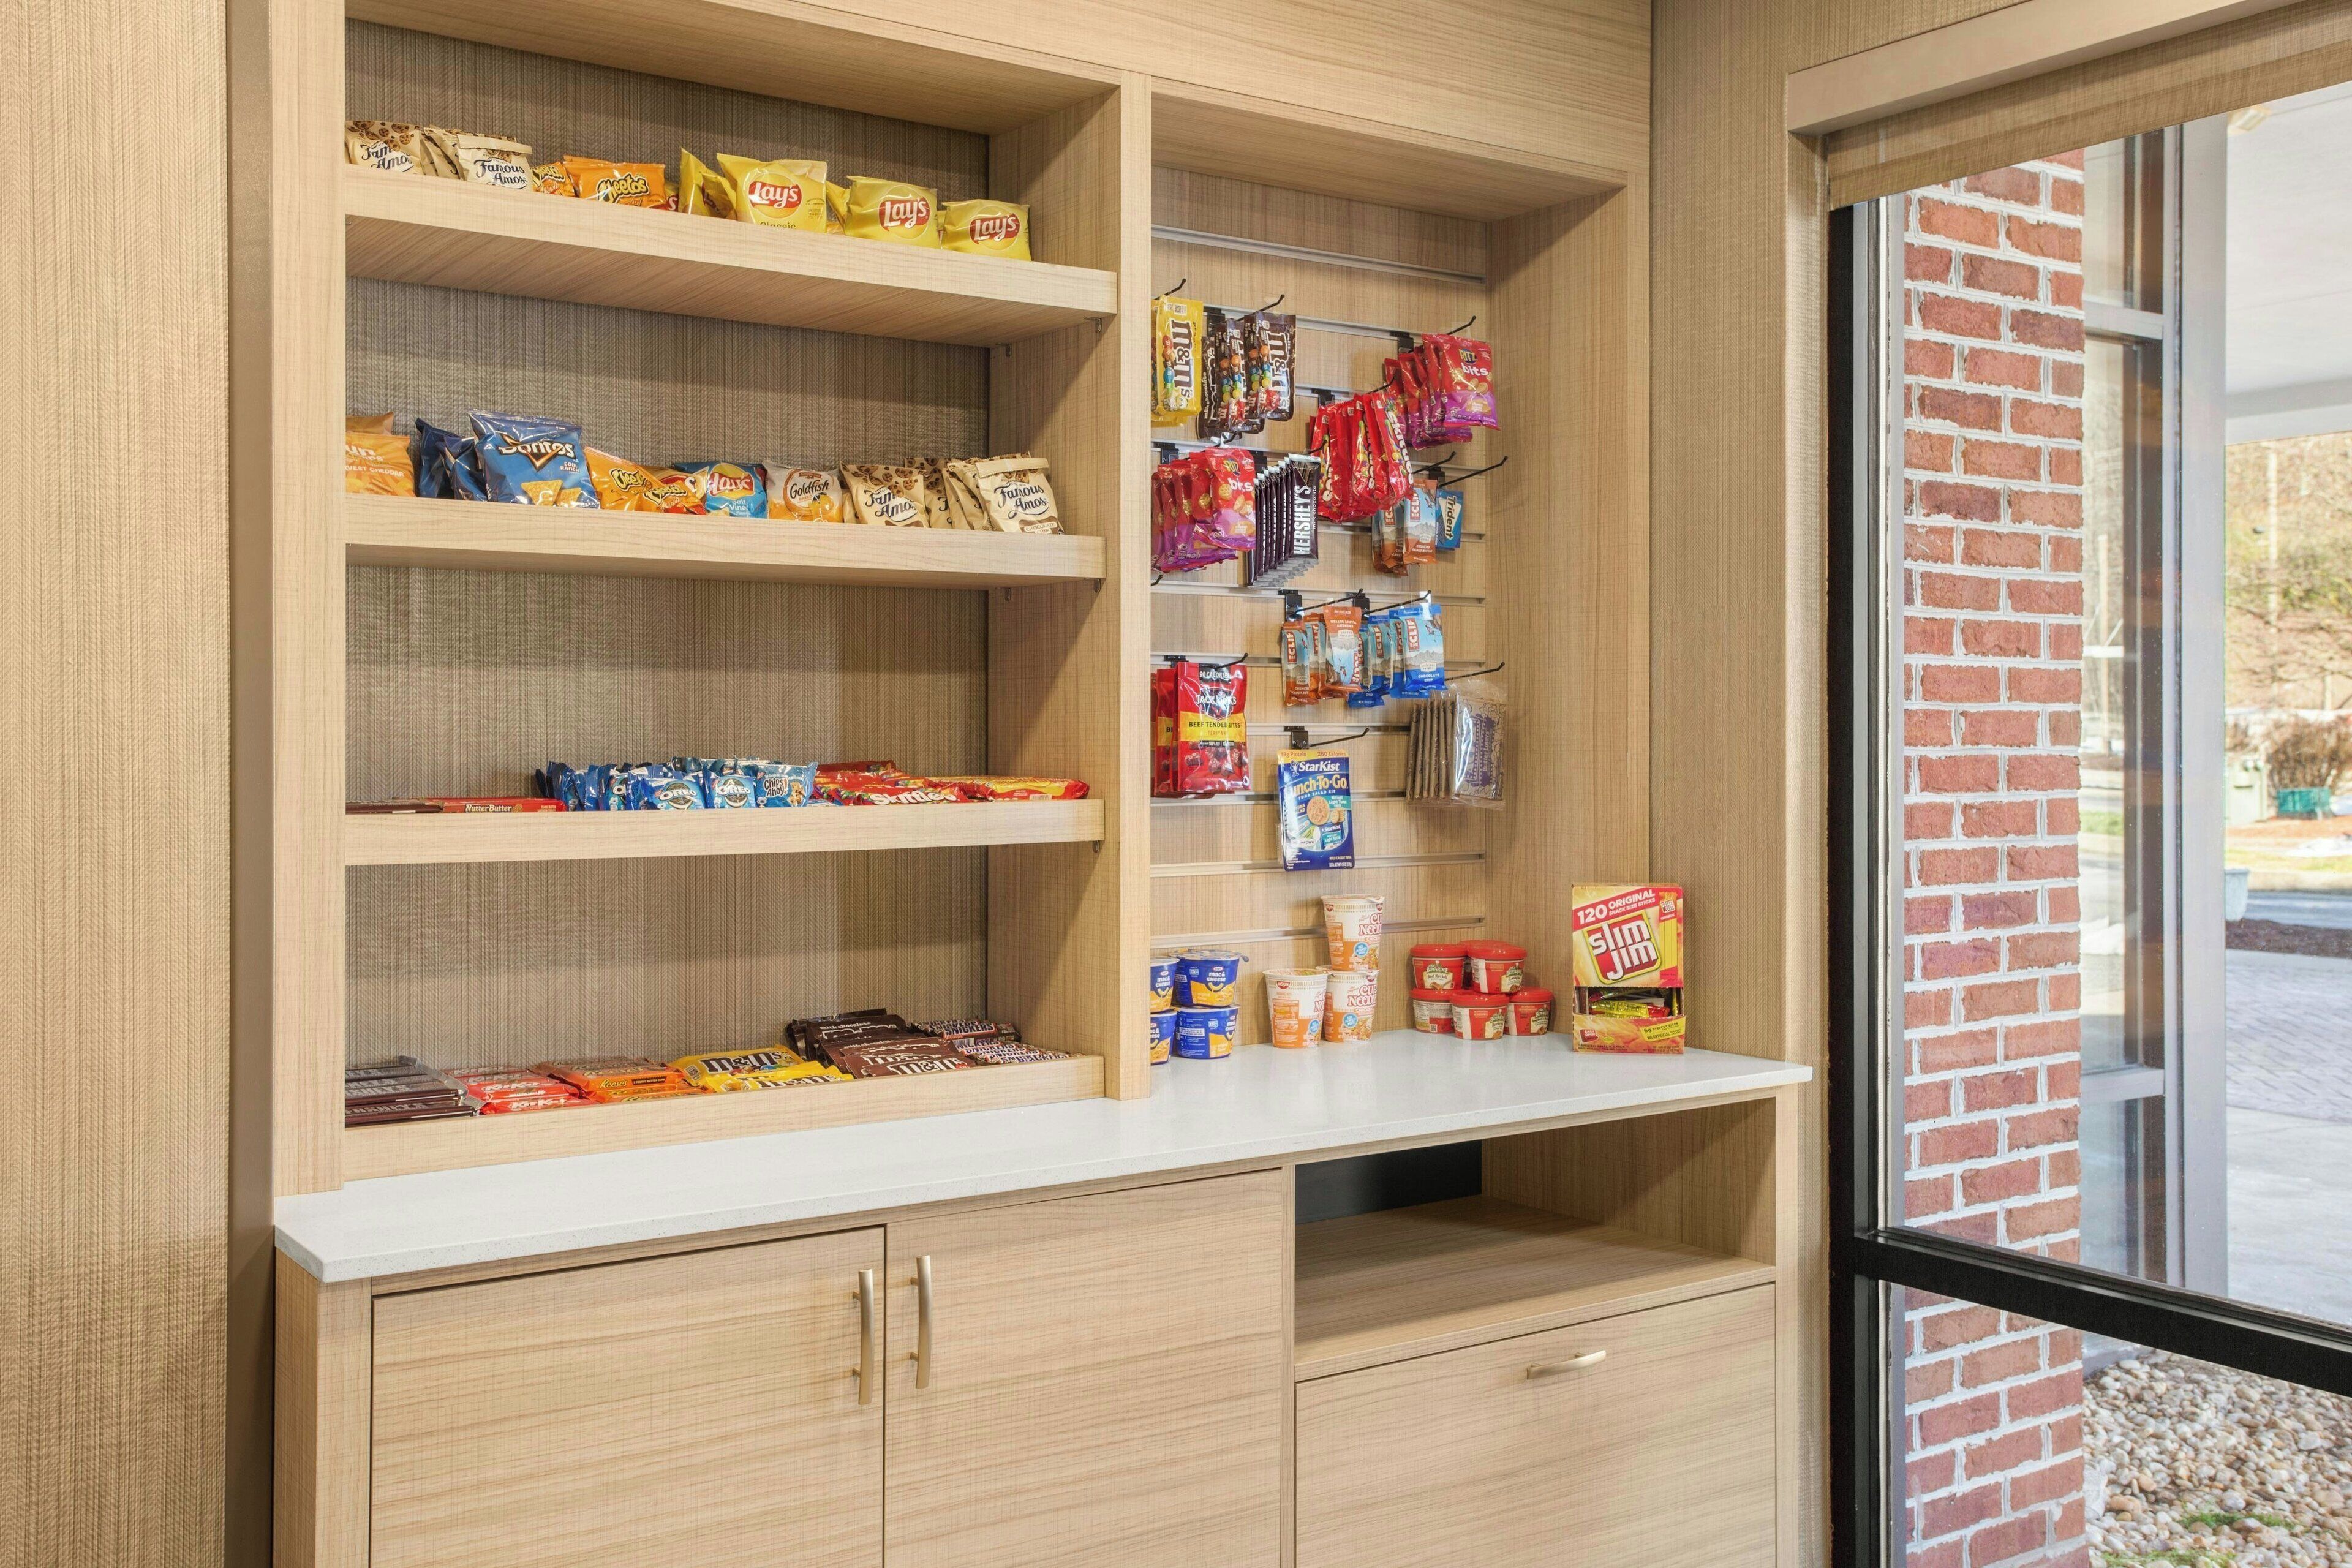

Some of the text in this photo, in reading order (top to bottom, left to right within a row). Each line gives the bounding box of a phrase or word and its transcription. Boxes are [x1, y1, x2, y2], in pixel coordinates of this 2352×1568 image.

[360, 144, 394, 160] Fam
[473, 158, 525, 178] Famous
[492, 172, 526, 184] Amos
[597, 174, 648, 203] Cheetos
[750, 182, 799, 209] Lay's
[884, 197, 927, 229] Lay's
[974, 215, 1016, 241] Lay's
[1459, 349, 1477, 361] RITZ
[1461, 363, 1488, 376] bits
[498, 441, 575, 459] Doritos
[369, 467, 404, 477] CHEDDAR
[790, 480, 829, 499] Goldfish
[864, 489, 896, 507] Fam
[994, 483, 1045, 508] Famous
[1008, 496, 1047, 519] Amos
[1294, 485, 1311, 554] HERSHEY'S
[1444, 495, 1457, 540] Trident
[1408, 619, 1418, 642] CLIF
[1298, 760, 1340, 772] StarKist
[717, 785, 751, 795] OREO
[764, 778, 784, 790] Chips
[659, 788, 697, 801] OREO
[466, 804, 512, 812] Nutter Butter
[1577, 889, 1656, 925] 120 ORIGINAL
[1609, 897, 1656, 916] SNACK SIZE STICKS
[946, 1022, 993, 1035] SNICKERS
[1653, 1022, 1678, 1030] PROTEIN
[957, 1041, 1000, 1049] NICKERS
